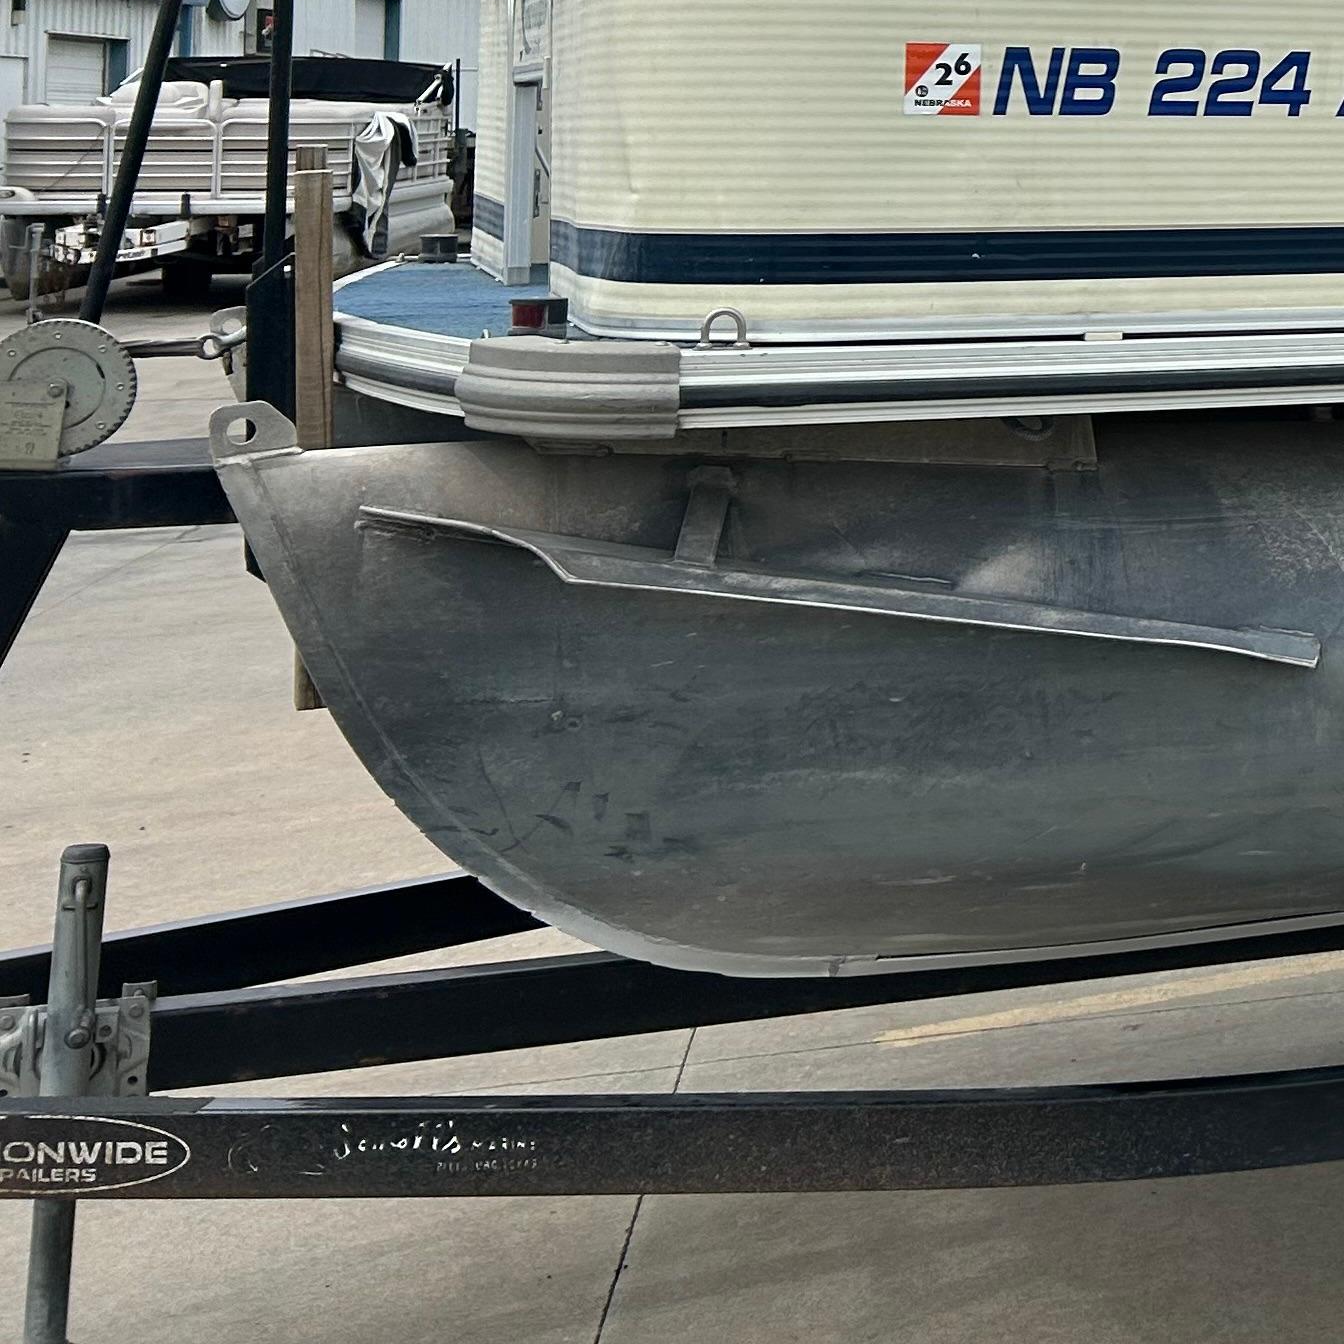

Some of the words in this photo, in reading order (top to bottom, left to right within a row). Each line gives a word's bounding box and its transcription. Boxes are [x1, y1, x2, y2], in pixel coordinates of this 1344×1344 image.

[934, 52, 972, 86] 26
[992, 47, 1121, 116] NB
[1147, 48, 1312, 117] 224
[914, 99, 972, 107] NEBRASKA
